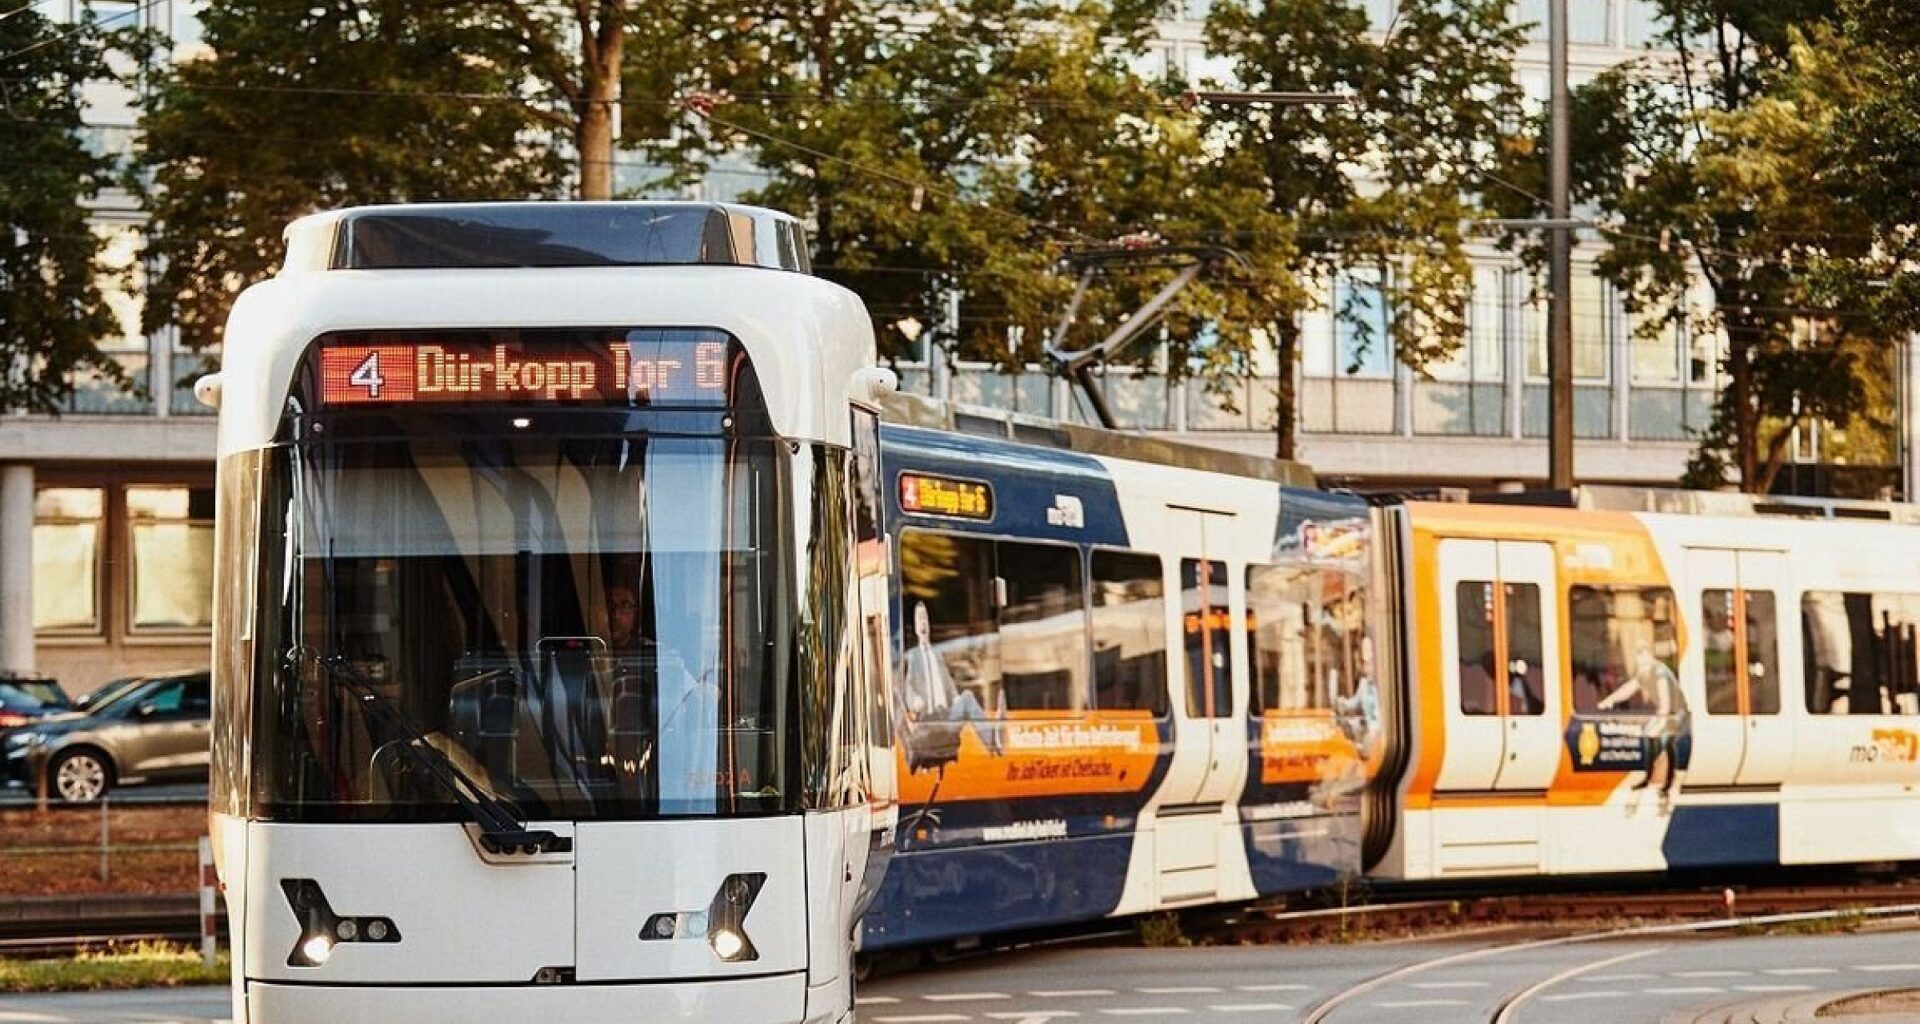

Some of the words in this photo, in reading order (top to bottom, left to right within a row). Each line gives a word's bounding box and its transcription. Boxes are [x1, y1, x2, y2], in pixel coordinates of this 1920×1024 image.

[349, 350, 385, 399] 4
[417, 345, 595, 399] Dürkopp
[610, 343, 682, 390] Tor
[694, 342, 723, 388] 6
